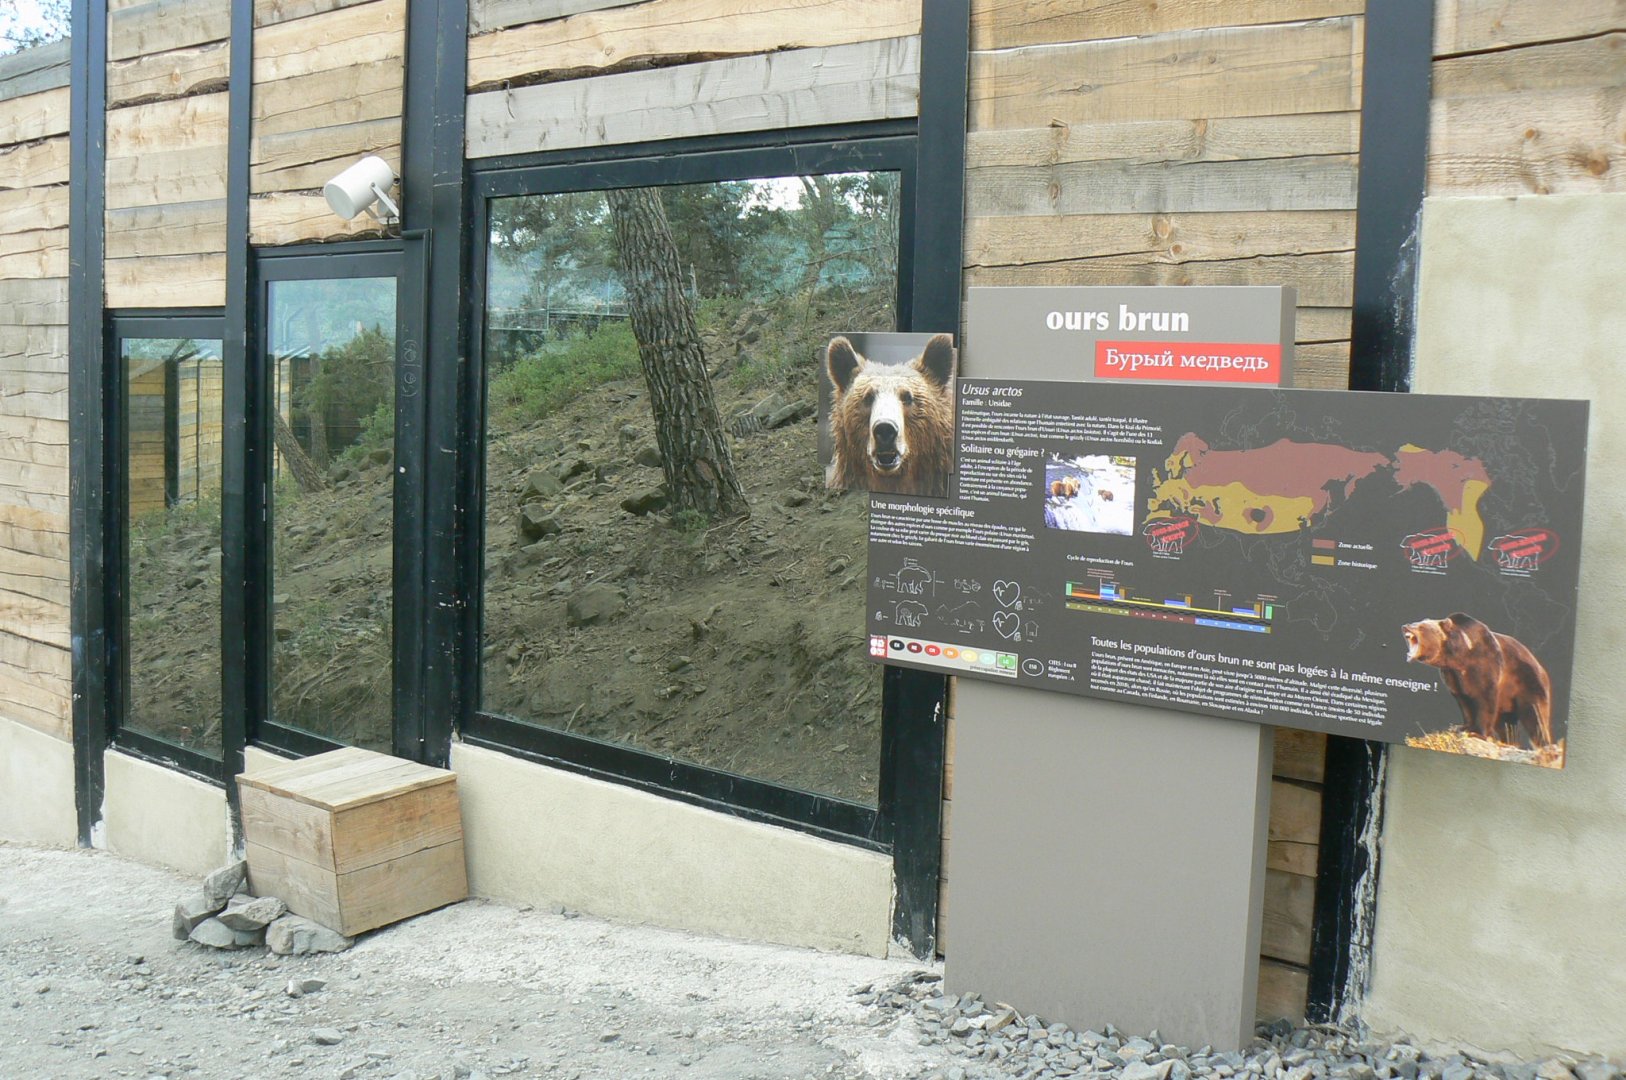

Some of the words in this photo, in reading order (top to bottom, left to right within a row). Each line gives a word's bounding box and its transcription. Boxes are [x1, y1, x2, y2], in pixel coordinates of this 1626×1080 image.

[1046, 310, 1110, 331] ours
[1118, 304, 1189, 332] brun
[1105, 348, 1174, 371] Бурый
[1180, 354, 1269, 372] медведь
[962, 383, 990, 395] Ursus
[992, 387, 1023, 397] arctos
[962, 398, 984, 406] Famille
[988, 400, 1012, 408] Ursidae
[960, 443, 993, 454] Solitaire
[994, 447, 1005, 455] ou
[1006, 447, 1039, 458] grégaire
[1040, 448, 1045, 457] ?
[871, 500, 887, 509] Une
[888, 503, 935, 516] morphologie
[936, 506, 975, 518] spécifique
[1091, 636, 1118, 649] Toutes
[1120, 639, 1132, 651] les
[1133, 643, 1186, 659] populations
[1187, 649, 1216, 663] d'ours
[1218, 653, 1239, 665] brun
[1242, 658, 1255, 668] ne
[1256, 660, 1276, 670] sont
[1278, 663, 1295, 674] pas
[1297, 663, 1328, 678] logées
[1330, 668, 1337, 679] à
[1340, 669, 1349, 680] la
[1351, 672, 1383, 685] même
[1385, 678, 1431, 692] enseigne
[1433, 682, 1438, 692] !
